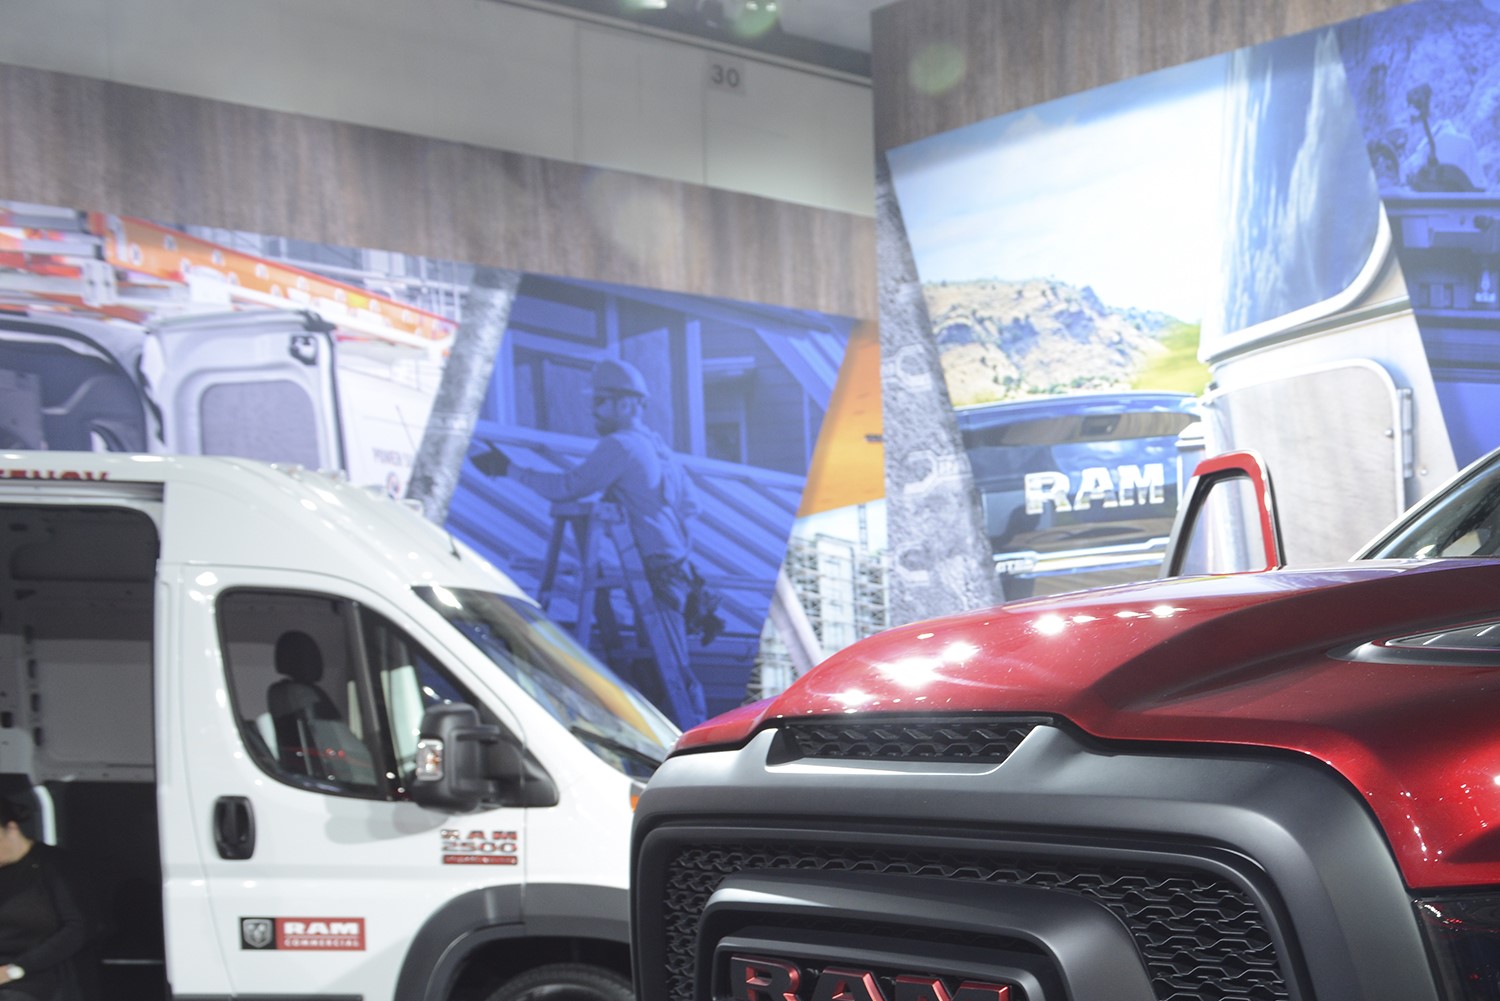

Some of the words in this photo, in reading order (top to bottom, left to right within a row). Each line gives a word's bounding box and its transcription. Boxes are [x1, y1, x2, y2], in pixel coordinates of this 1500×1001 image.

[711, 64, 740, 88] 30
[1024, 463, 1165, 515] RAM
[441, 830, 517, 840] RAM
[442, 841, 517, 853] 2500
[283, 922, 359, 935] RAM
[284, 938, 359, 948] COMMERCIAL
